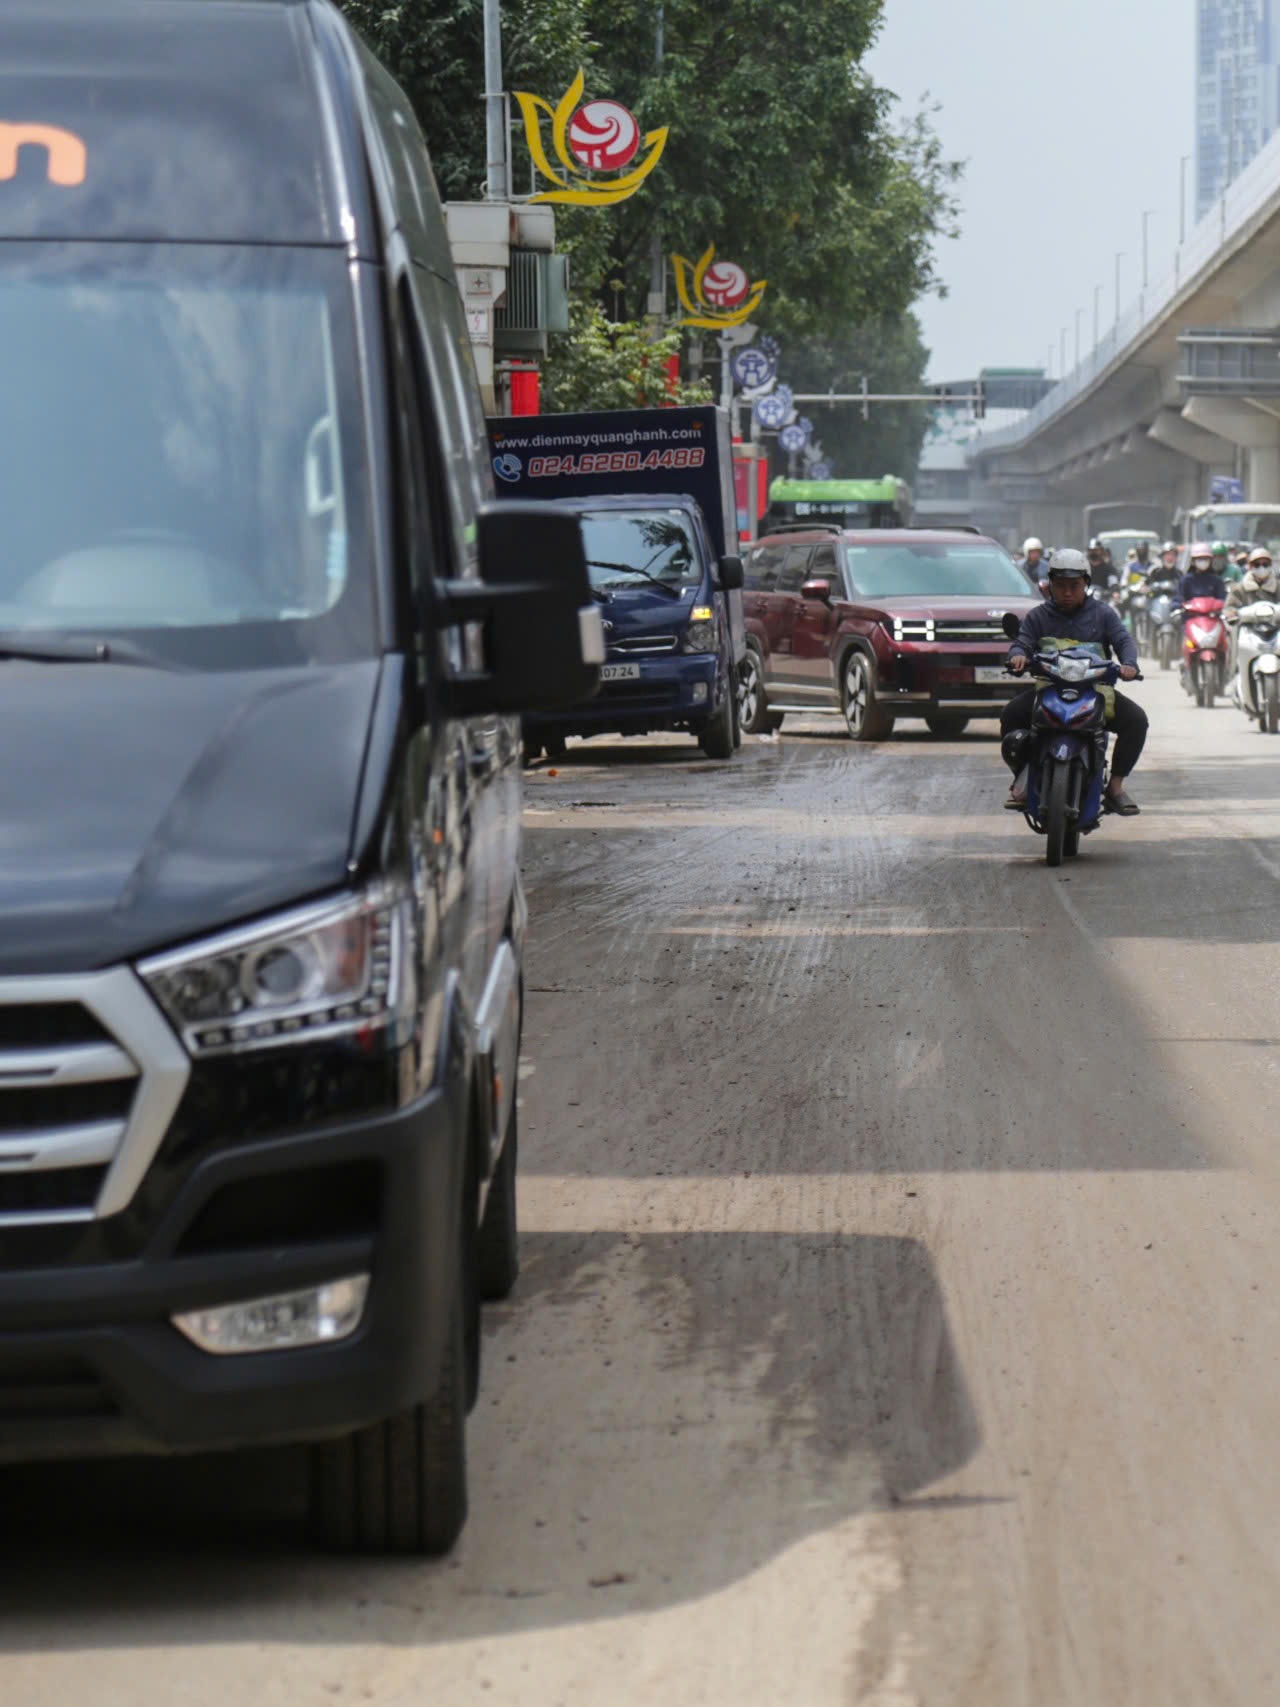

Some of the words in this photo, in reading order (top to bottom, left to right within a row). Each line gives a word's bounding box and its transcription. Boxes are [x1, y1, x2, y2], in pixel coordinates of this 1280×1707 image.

[494, 427, 702, 449] www.dienmayquanghanh.com
[528, 447, 705, 477] 024.6260.4488
[601, 666, 635, 679] 07.24
